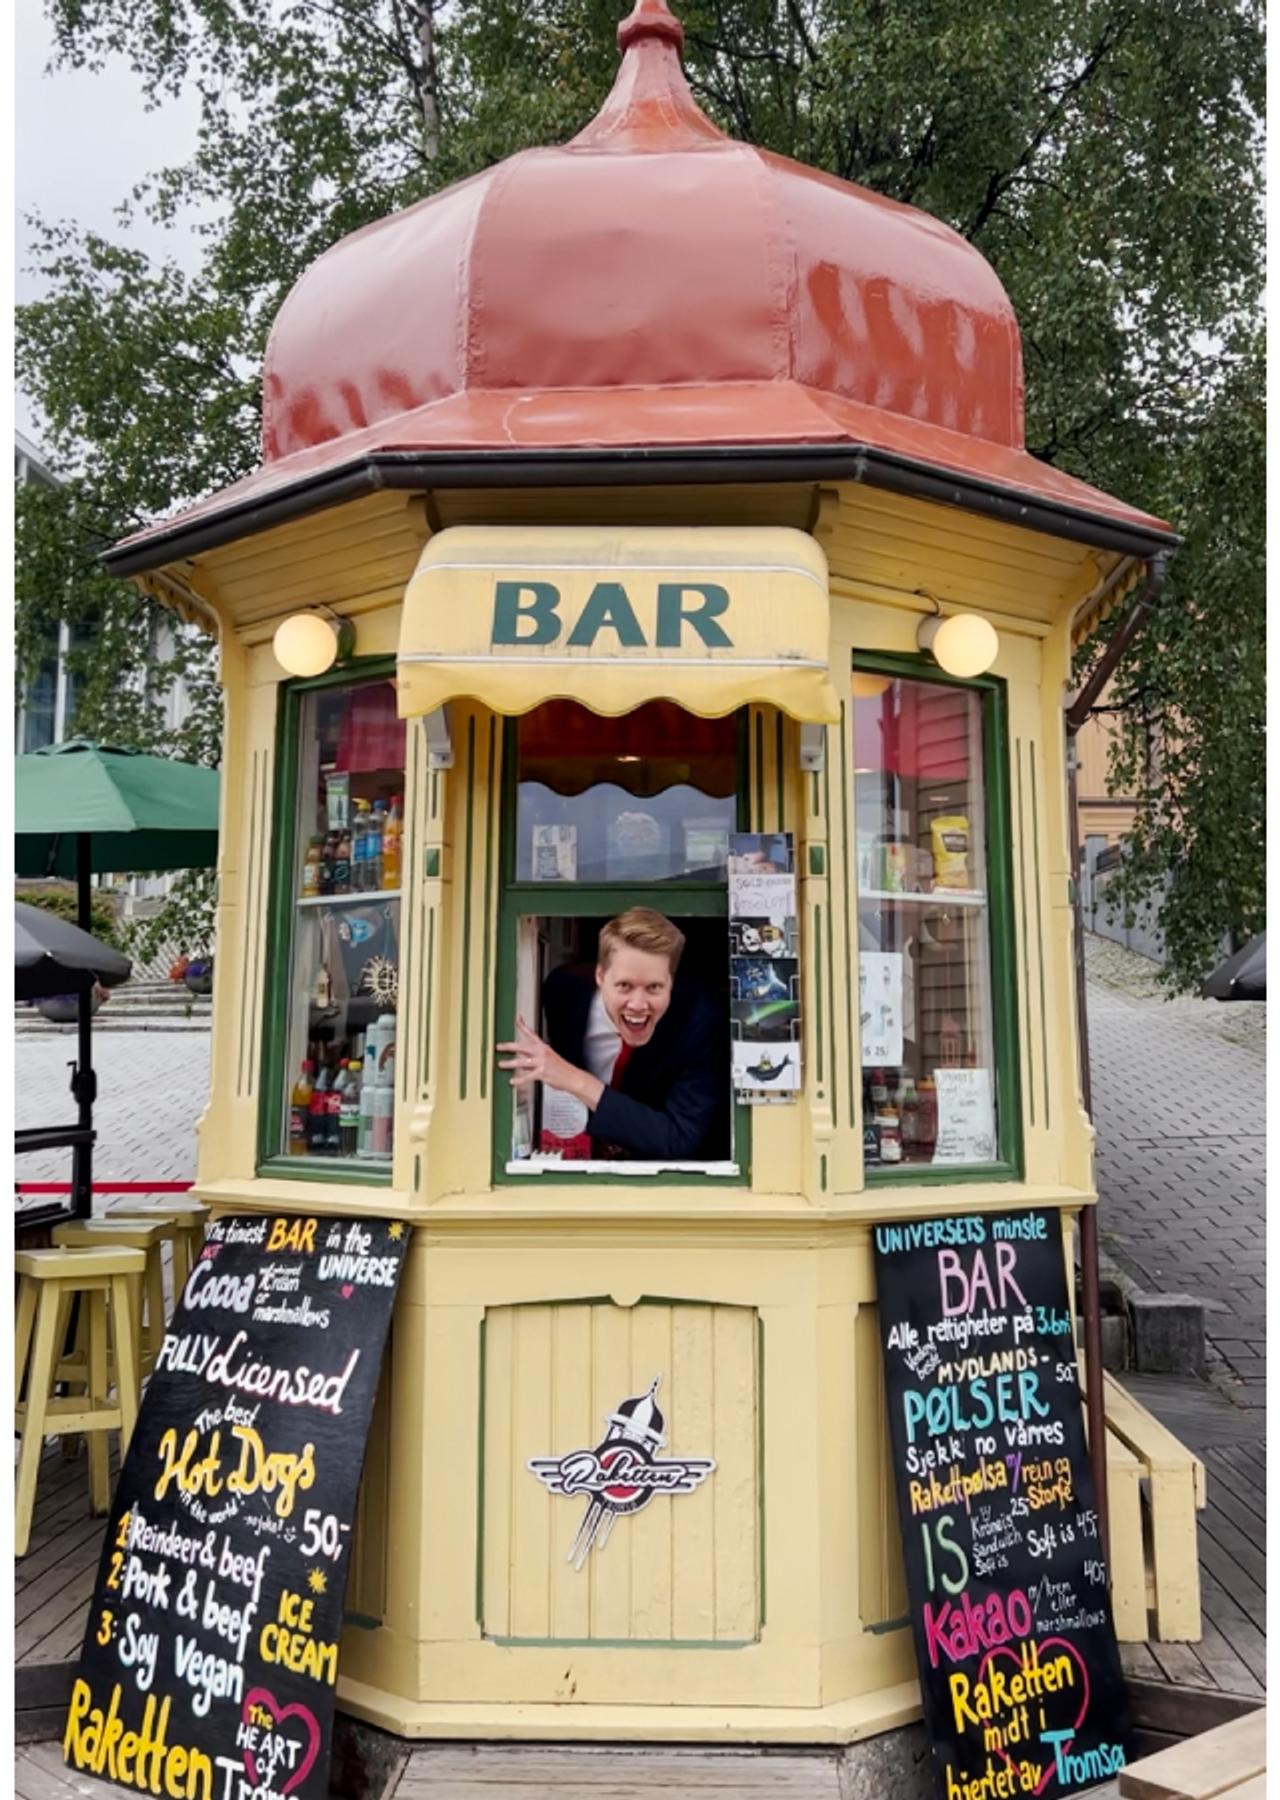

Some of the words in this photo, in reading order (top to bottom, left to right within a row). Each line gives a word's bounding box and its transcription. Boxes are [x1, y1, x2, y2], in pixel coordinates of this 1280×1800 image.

[490, 580, 734, 648] BAR
[204, 1221, 225, 1241] The
[265, 1219, 317, 1256] BAR
[326, 1222, 340, 1248] in
[341, 1225, 371, 1255] the
[876, 1216, 986, 1254] UNIVERSETS
[992, 1211, 1048, 1241] minste
[184, 1260, 256, 1313] Cocoa
[255, 1292, 270, 1304] or
[318, 1255, 399, 1287] UNIVERSE
[938, 1241, 1027, 1316] BAR
[252, 1295, 330, 1328] marshmallows
[887, 1322, 919, 1350] Alle
[927, 1309, 1007, 1350] rettigheter
[1013, 1304, 1035, 1344] på
[155, 1333, 220, 1374] FULLY
[207, 1330, 360, 1413] Licensed
[195, 1407, 221, 1435] The
[221, 1395, 261, 1428] best
[904, 1372, 1050, 1443] PØLSER
[155, 1427, 222, 1500] Hot
[228, 1425, 316, 1516] Dogs
[560, 1449, 686, 1494] Raketten
[906, 1438, 966, 1477] Sjekk
[975, 1435, 997, 1456] no
[1004, 1419, 1064, 1448] vårres
[190, 1500, 207, 1523] the
[909, 1456, 1008, 1515] Rakettpølsa
[1022, 1456, 1053, 1483] rein
[1055, 1457, 1072, 1486] og
[130, 1515, 202, 1564] Reindeer
[199, 1530, 217, 1570] &
[218, 1535, 270, 1603] beef
[922, 1515, 969, 1593] IS
[1027, 1523, 1057, 1559] Soft
[1060, 1523, 1075, 1544] is
[122, 1555, 171, 1610] Pork
[176, 1569, 199, 1620] &
[202, 1580, 258, 1662] beef
[277, 1590, 314, 1629] ICE
[924, 1590, 1032, 1668] Kakao
[96, 1610, 118, 1646] 3:
[119, 1613, 160, 1691] Soy
[174, 1634, 244, 1717] Vegan
[259, 1623, 338, 1685] CREAM
[949, 1640, 1074, 1733] Raketten
[64, 1678, 213, 1800] Raketten
[248, 1704, 273, 1730] The
[984, 1705, 1029, 1751] midt
[1040, 1697, 1047, 1730] i
[236, 1722, 303, 1769] HEART
[256, 1757, 276, 1789] of
[1020, 1760, 1042, 1792] av
[1040, 1728, 1126, 1785] Tromsø
